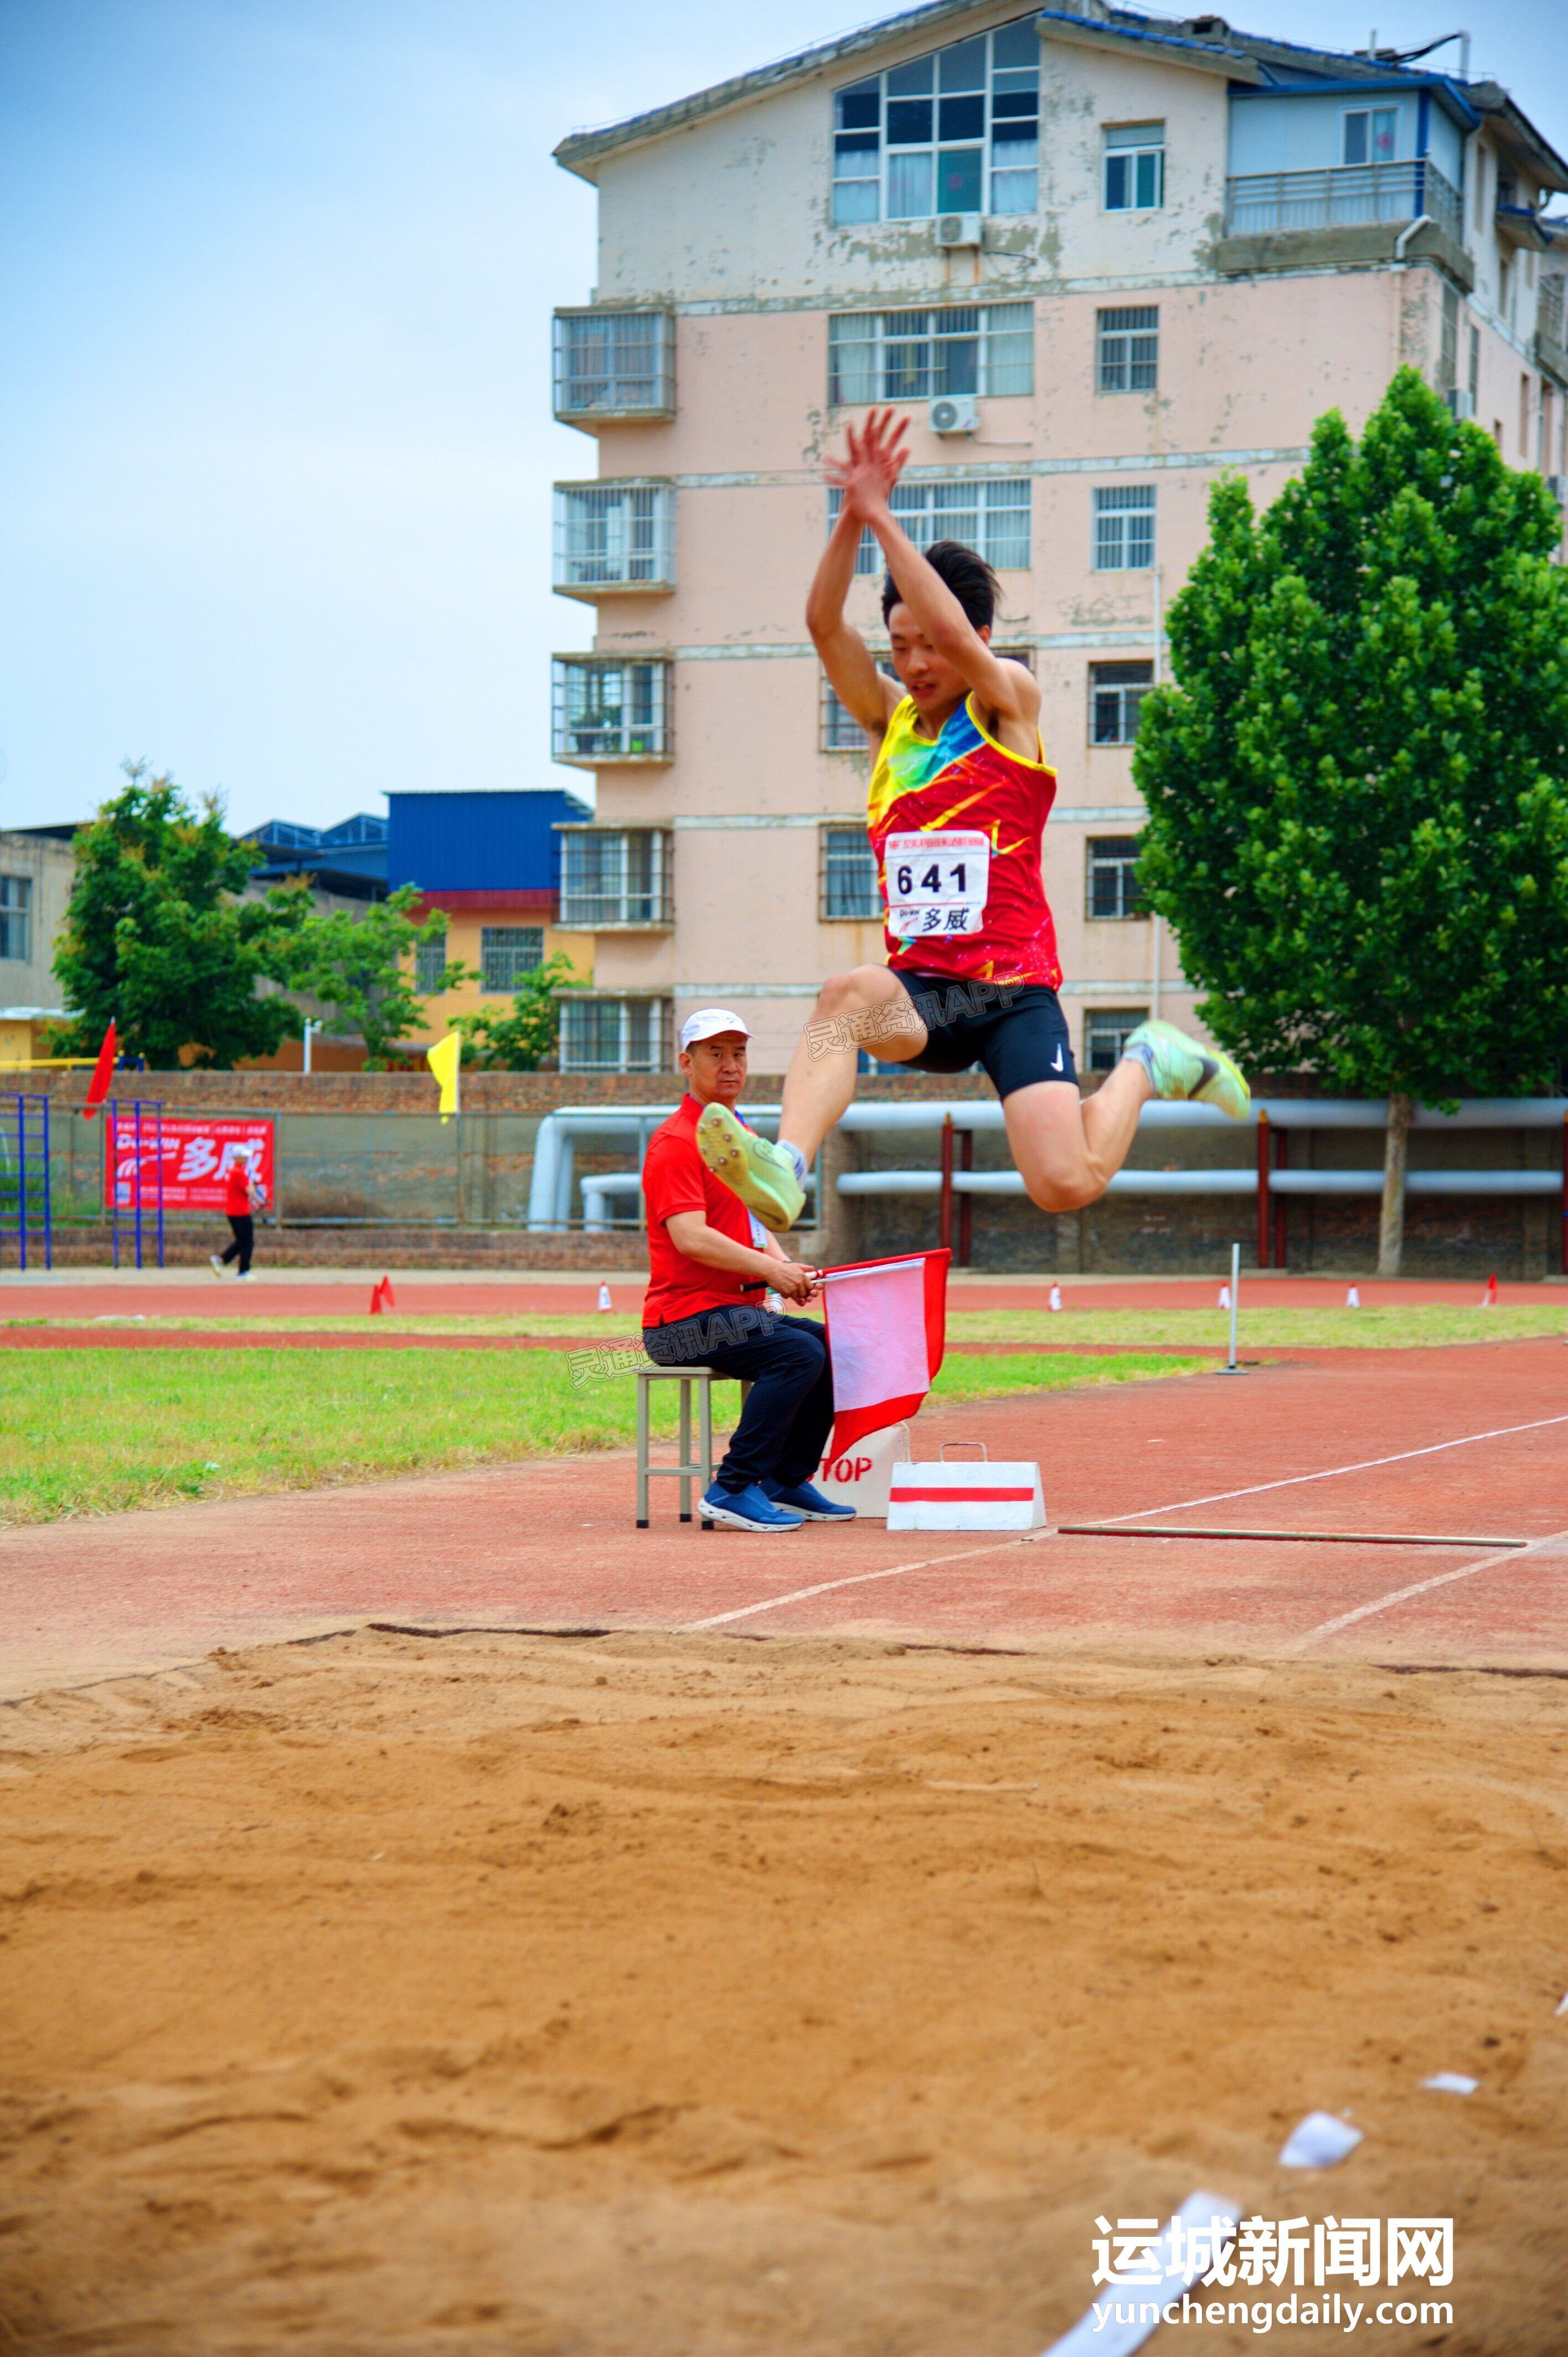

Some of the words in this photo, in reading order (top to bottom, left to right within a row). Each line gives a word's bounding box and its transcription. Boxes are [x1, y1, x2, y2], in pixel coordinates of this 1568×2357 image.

[898, 862, 966, 895] 641
[922, 907, 969, 932] 多威
[806, 1457, 873, 1483] TOP
